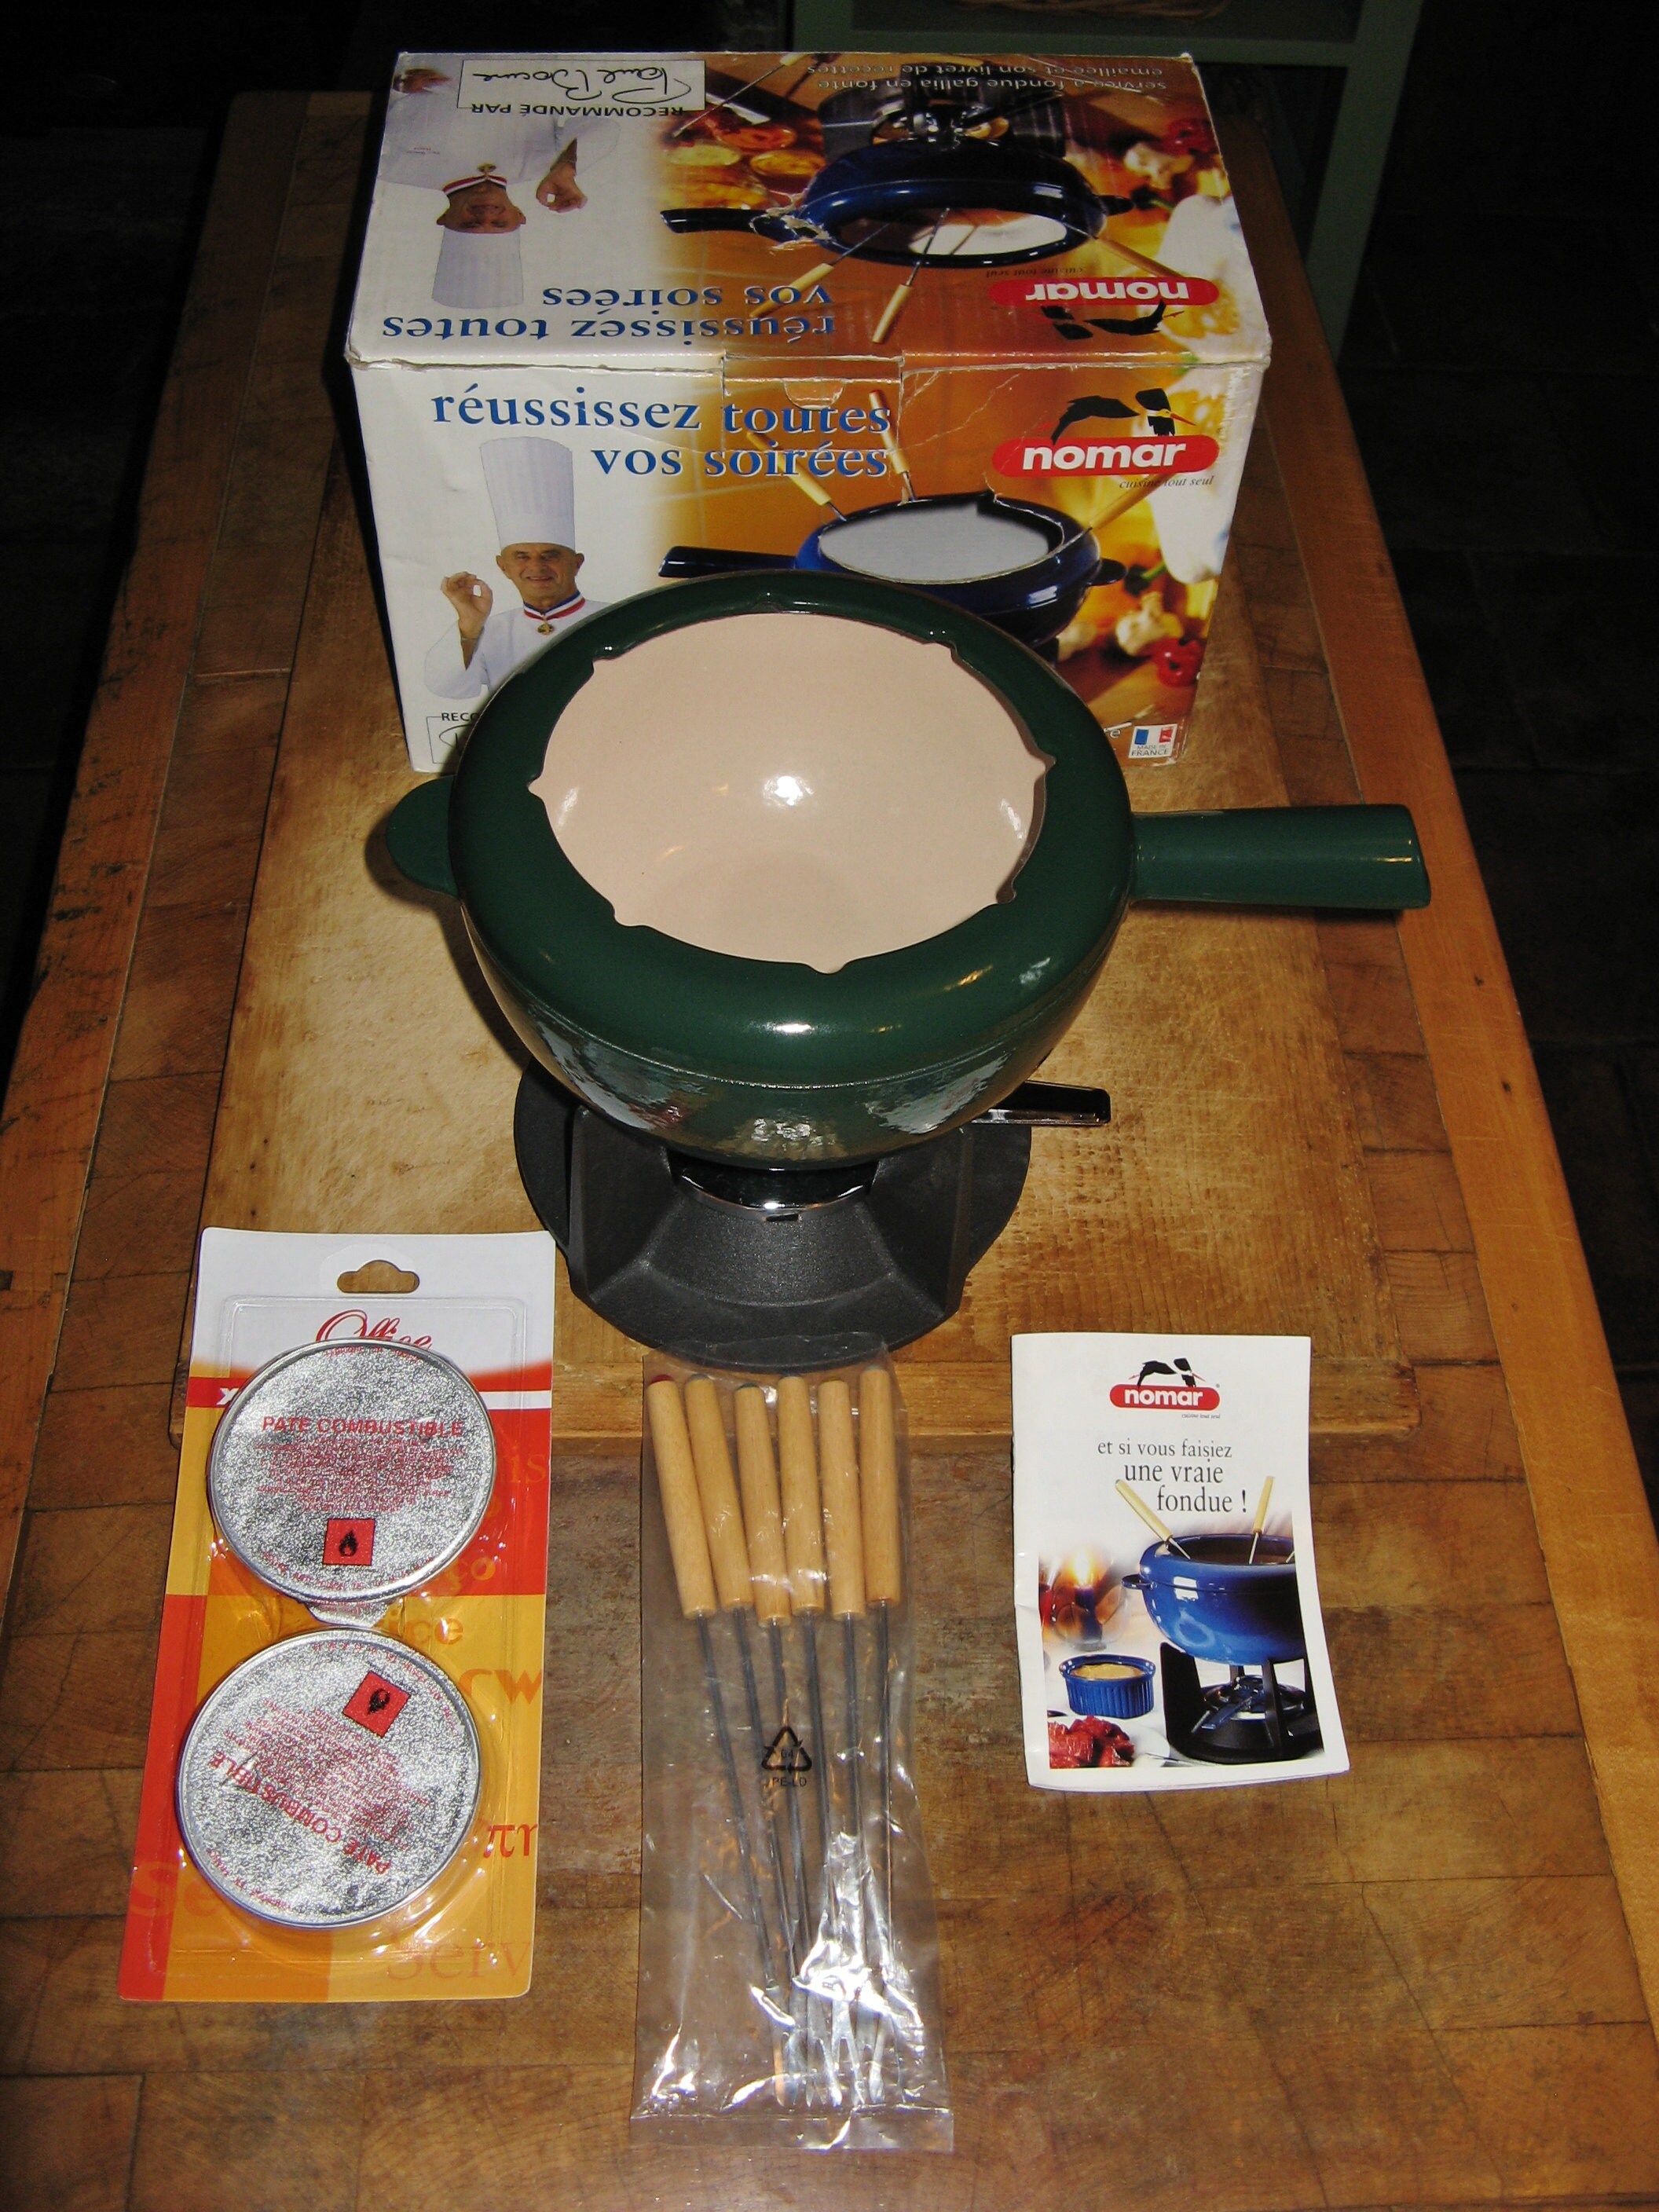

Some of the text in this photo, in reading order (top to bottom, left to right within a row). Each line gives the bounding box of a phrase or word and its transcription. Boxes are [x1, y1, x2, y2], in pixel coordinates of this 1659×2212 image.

[902, 65, 928, 75] de
[936, 65, 991, 76] livret
[818, 80, 878, 92] fonte
[921, 78, 979, 90] gallia
[987, 79, 1066, 91] fondue
[471, 103, 685, 117] RECOMMANDÉ PAR
[542, 284, 834, 315] vos soirées
[1024, 281, 1190, 301] nomar
[383, 315, 836, 346] réussissez toutes
[430, 383, 891, 433] réussissez toutes
[591, 439, 888, 478] vos soirées
[1022, 441, 1187, 471] nomar
[1190, 475, 1215, 486] seul
[1124, 1387, 1203, 1406] nomar
[317, 1417, 466, 1437] COMBUSTIBLE
[1097, 1437, 1232, 1458] et si vous faisiez
[1124, 1458, 1224, 1483] une vraie
[1156, 1485, 1232, 1513] fondue
[208, 1749, 342, 1844] COMBUSTIBLE
